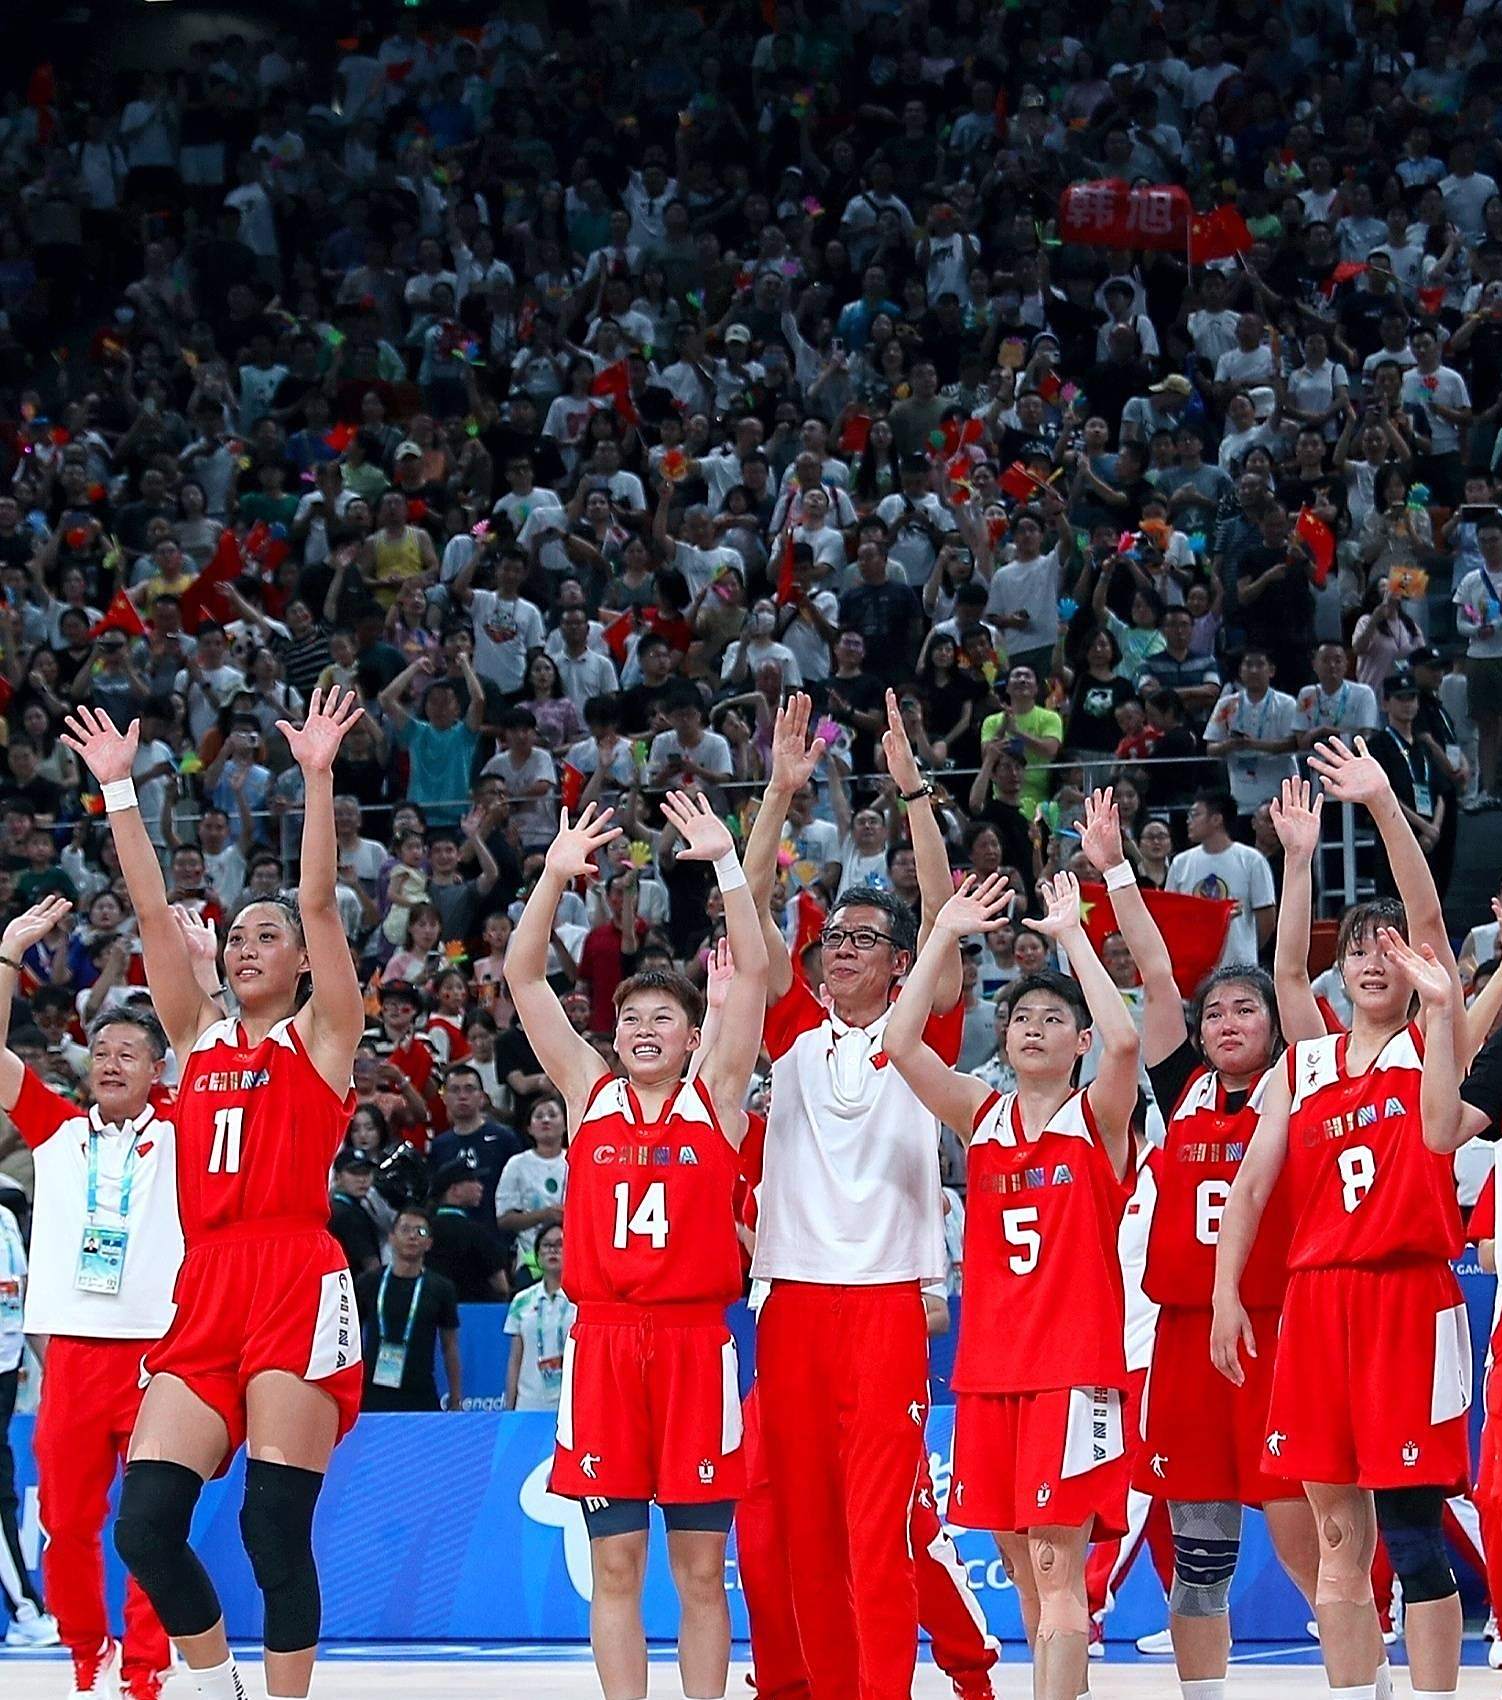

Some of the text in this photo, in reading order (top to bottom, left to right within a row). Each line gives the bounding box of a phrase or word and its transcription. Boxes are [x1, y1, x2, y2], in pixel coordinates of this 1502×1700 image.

[194, 1068, 270, 1092] CHINA
[208, 1107, 244, 1174] 11
[593, 1145, 699, 1166] CHINA
[1196, 1180, 1232, 1244] 6
[1338, 1145, 1376, 1214] 8
[613, 1182, 669, 1249] 14
[1002, 1206, 1042, 1276] 5
[440, 1392, 506, 1412] Cengd
